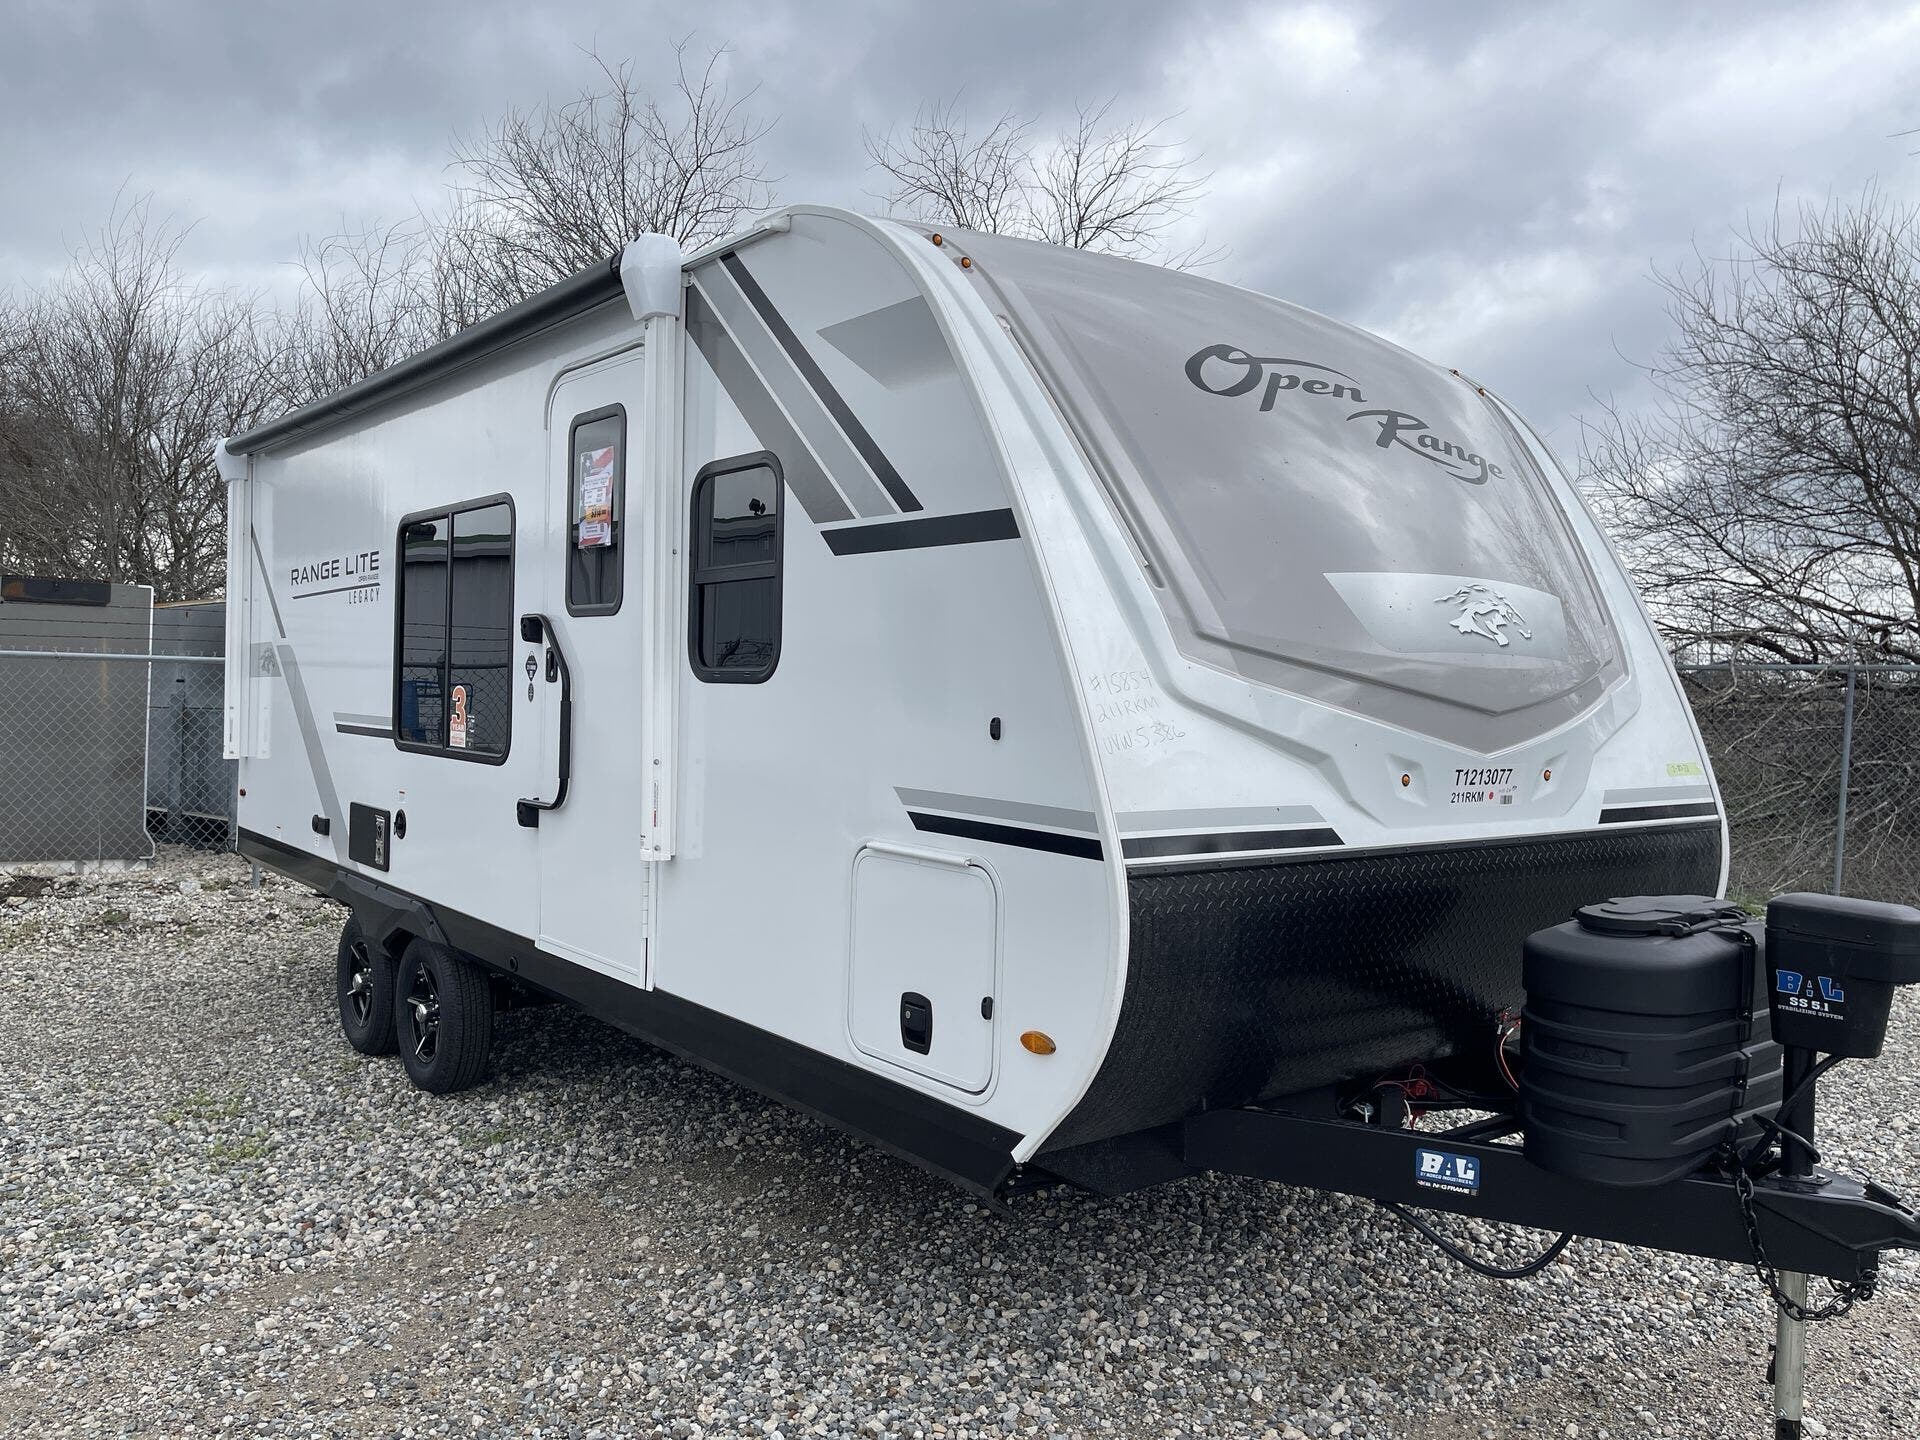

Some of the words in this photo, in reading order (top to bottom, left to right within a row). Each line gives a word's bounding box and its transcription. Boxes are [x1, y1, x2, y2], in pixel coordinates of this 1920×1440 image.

[1185, 344, 1367, 412] Open
[1346, 410, 1505, 485] Range
[291, 559, 340, 586] RANGE
[346, 551, 380, 575] LITE
[348, 587, 380, 604] LEGACY
[1088, 667, 1152, 695] #15854
[452, 685, 466, 725] 3
[1095, 696, 1160, 723] 211RKM
[451, 723, 466, 732] YEAR
[1455, 768, 1513, 786] T1213077
[1450, 791, 1484, 804] 211RKM
[1778, 1004, 1817, 1016] STABILIZING
[1817, 1011, 1844, 1021] SYSTEM
[1789, 995, 1808, 1008] SS
[1811, 999, 1830, 1012] 5.1
